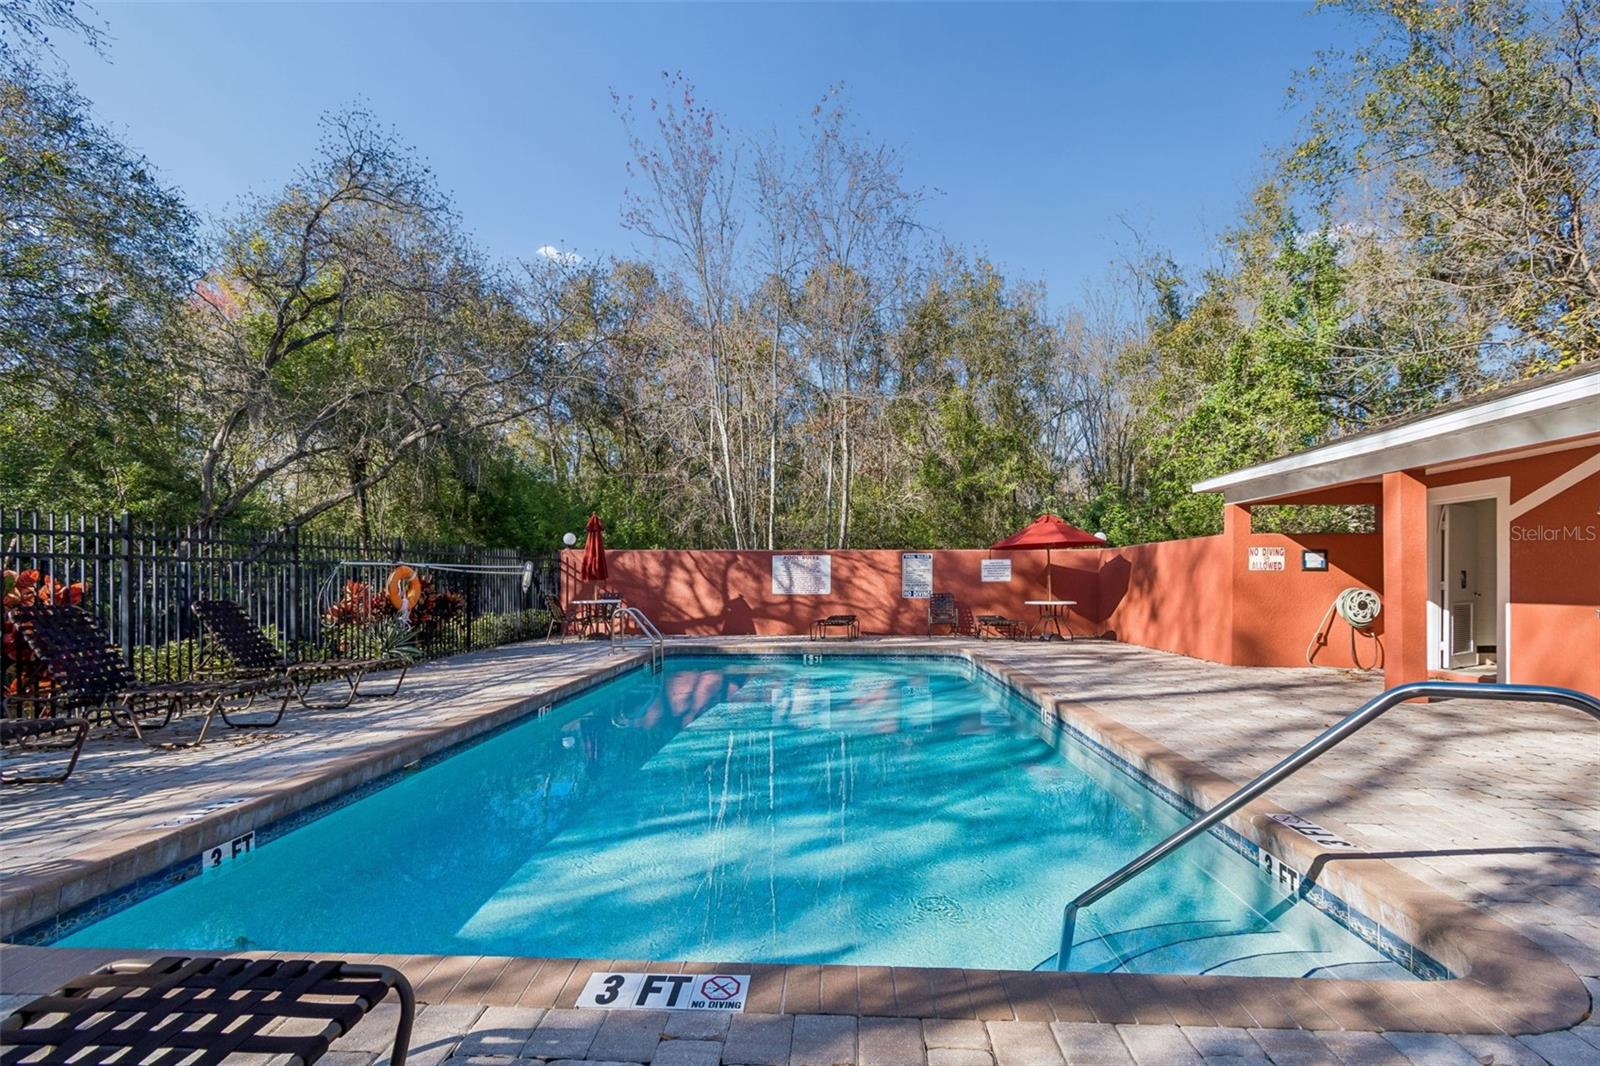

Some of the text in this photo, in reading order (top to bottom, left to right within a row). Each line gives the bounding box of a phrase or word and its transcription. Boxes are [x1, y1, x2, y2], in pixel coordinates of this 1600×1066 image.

[1249, 548, 1284, 556] NO DIVING
[1252, 561, 1283, 570] ALLOWED
[211, 832, 253, 868] 3 FT
[1264, 854, 1298, 892] 3 FT
[594, 974, 694, 1007] 3 FT
[691, 1000, 742, 1010] NO DIVING
